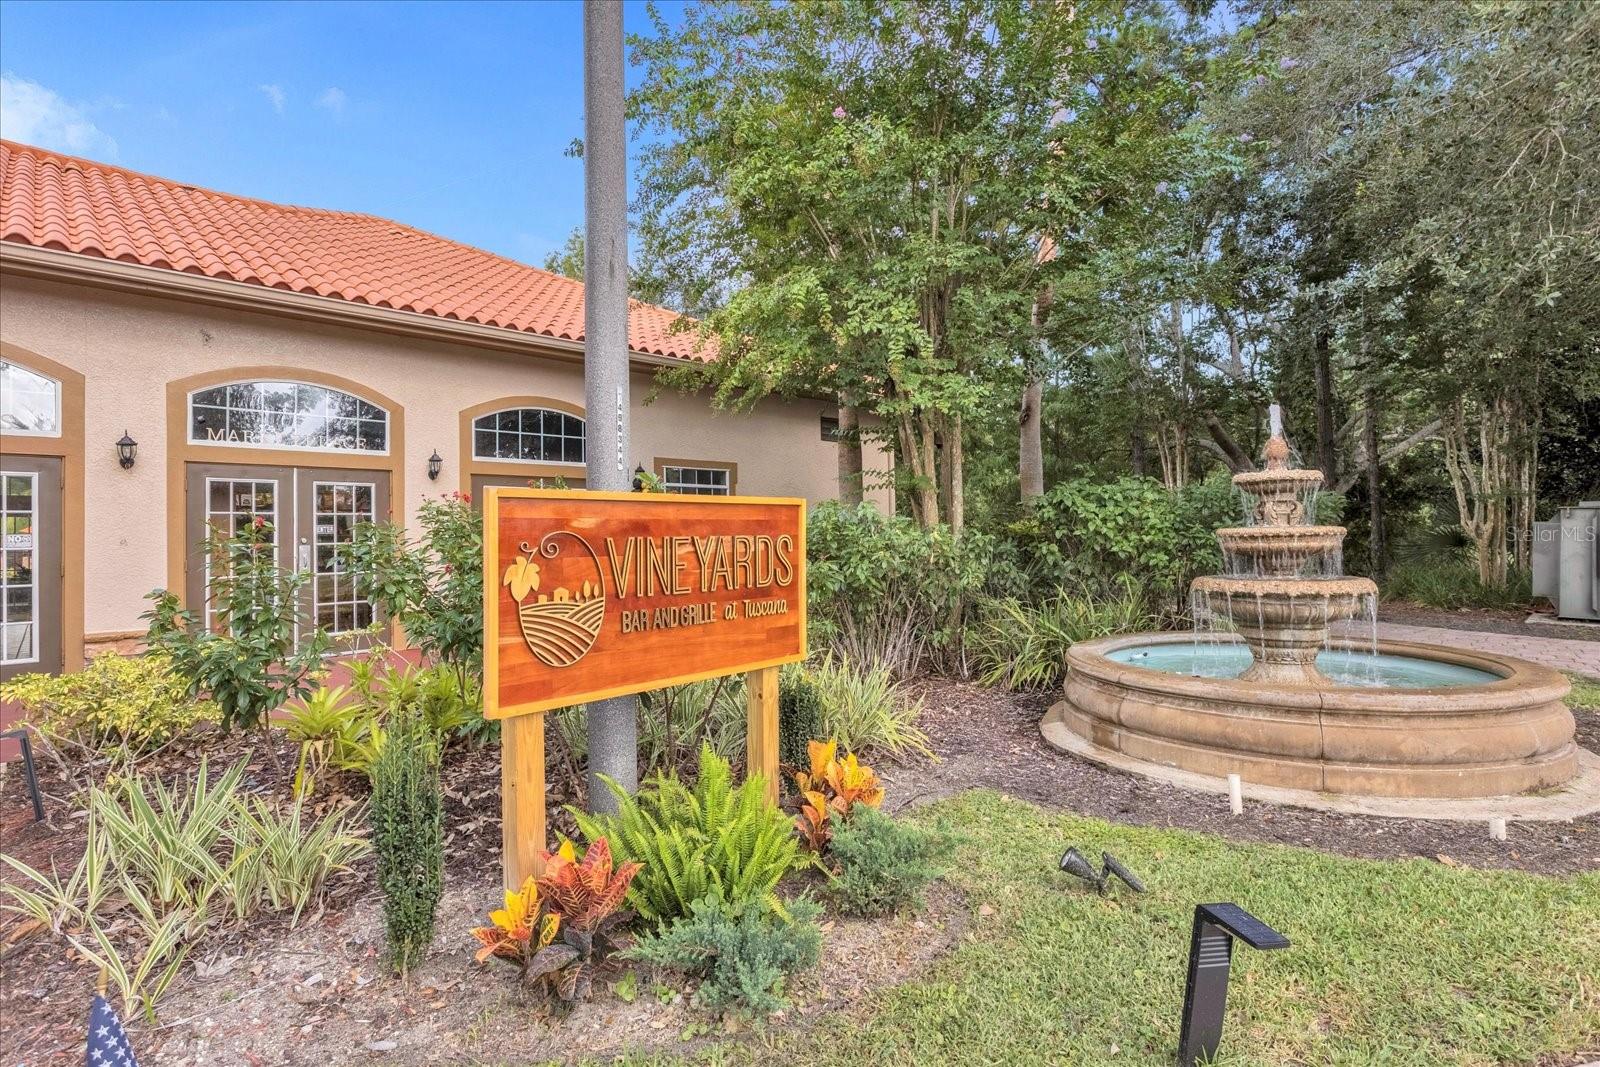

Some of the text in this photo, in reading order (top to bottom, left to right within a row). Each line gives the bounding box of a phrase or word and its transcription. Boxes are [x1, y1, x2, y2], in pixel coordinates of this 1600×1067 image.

[606, 534, 793, 599] VINEYARDS
[622, 600, 788, 633] BAR AND GRILLE at Tuscana
